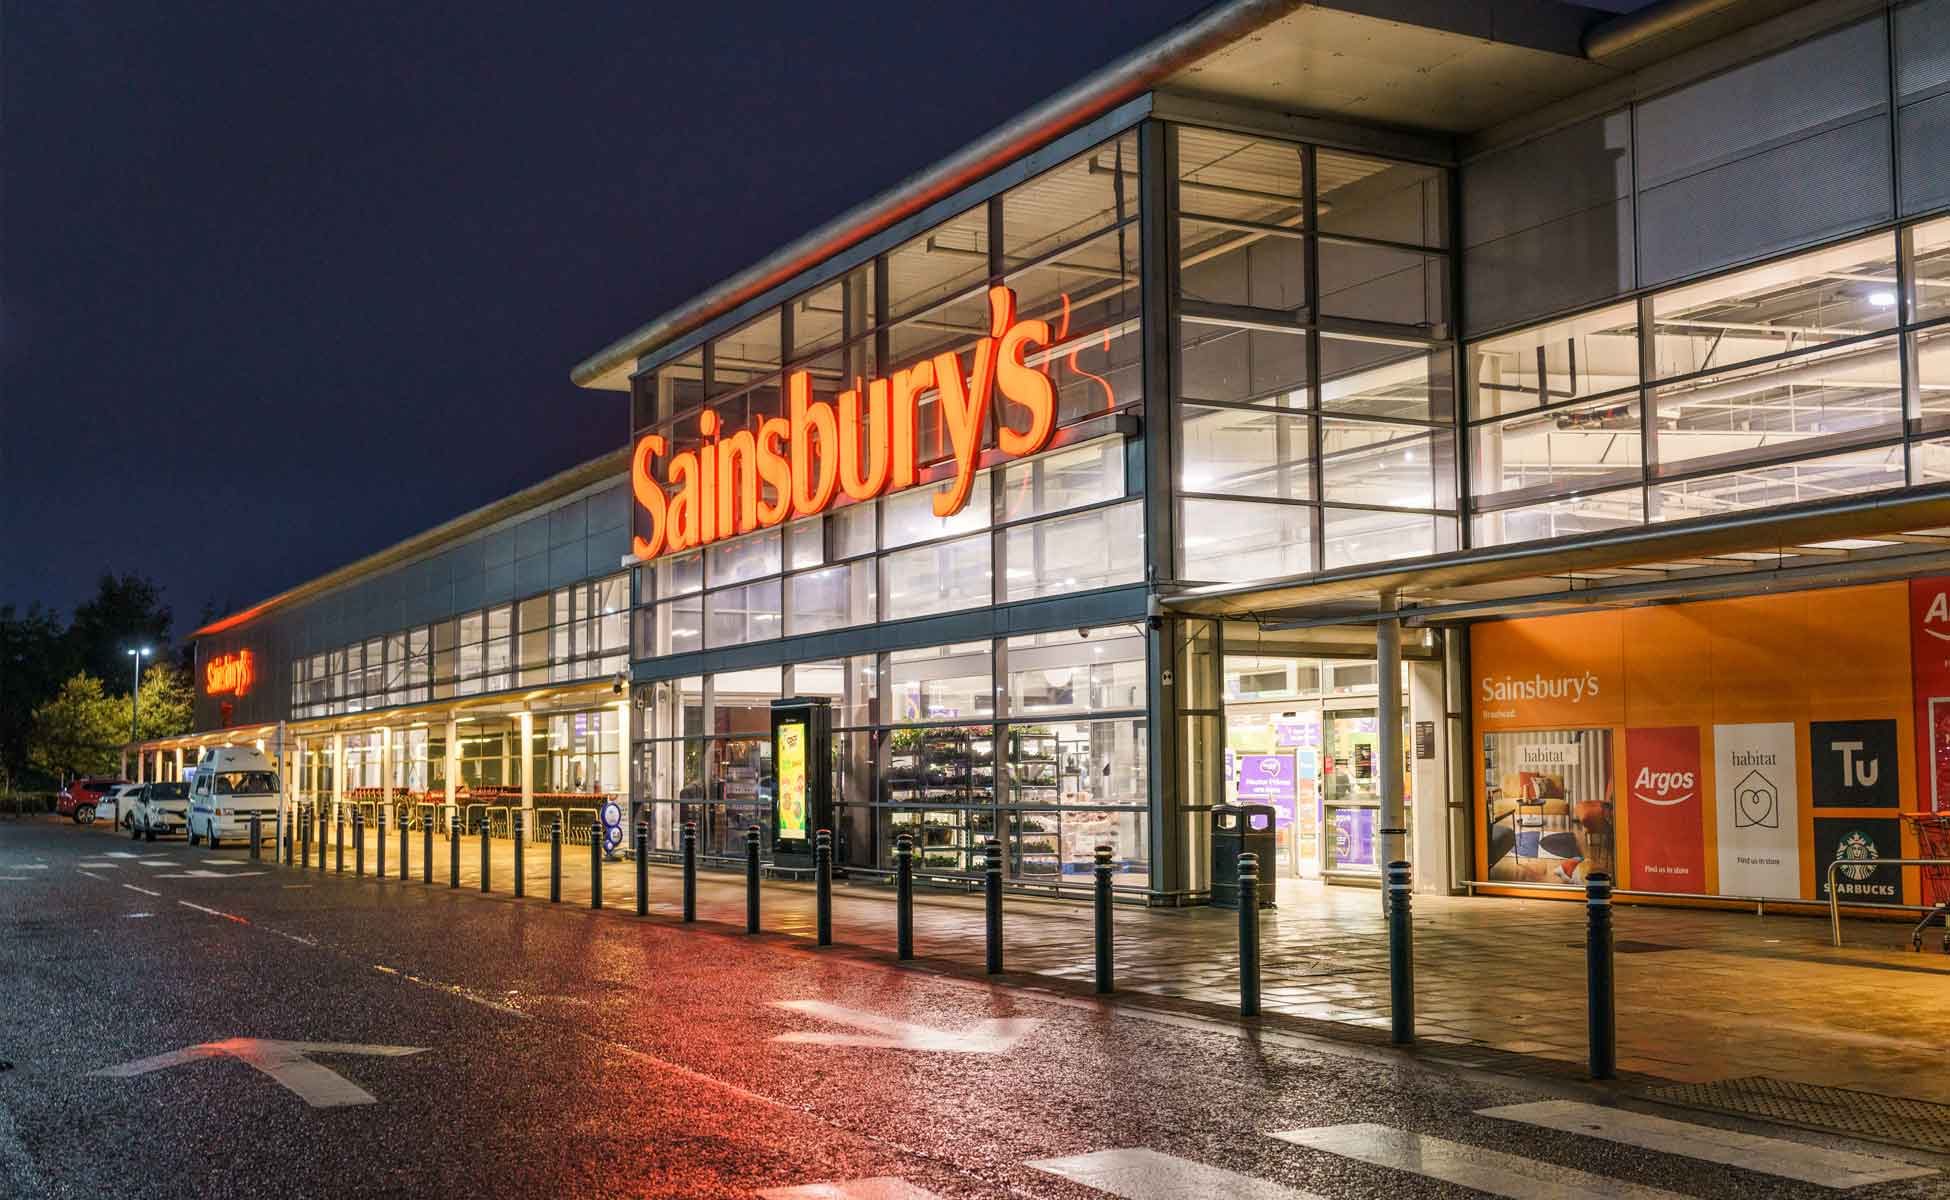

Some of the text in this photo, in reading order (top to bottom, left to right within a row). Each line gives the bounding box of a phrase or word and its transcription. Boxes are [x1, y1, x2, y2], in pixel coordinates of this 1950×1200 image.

[632, 286, 1057, 560] Sainsbury's
[1924, 592, 1950, 623] A
[1482, 671, 1600, 703] Sainsbury's
[1524, 747, 1564, 762] habitat
[1732, 751, 1777, 767] habitat
[1831, 741, 1879, 787] Tu
[1634, 767, 1694, 796] Argos
[1645, 864, 1658, 873] Find
